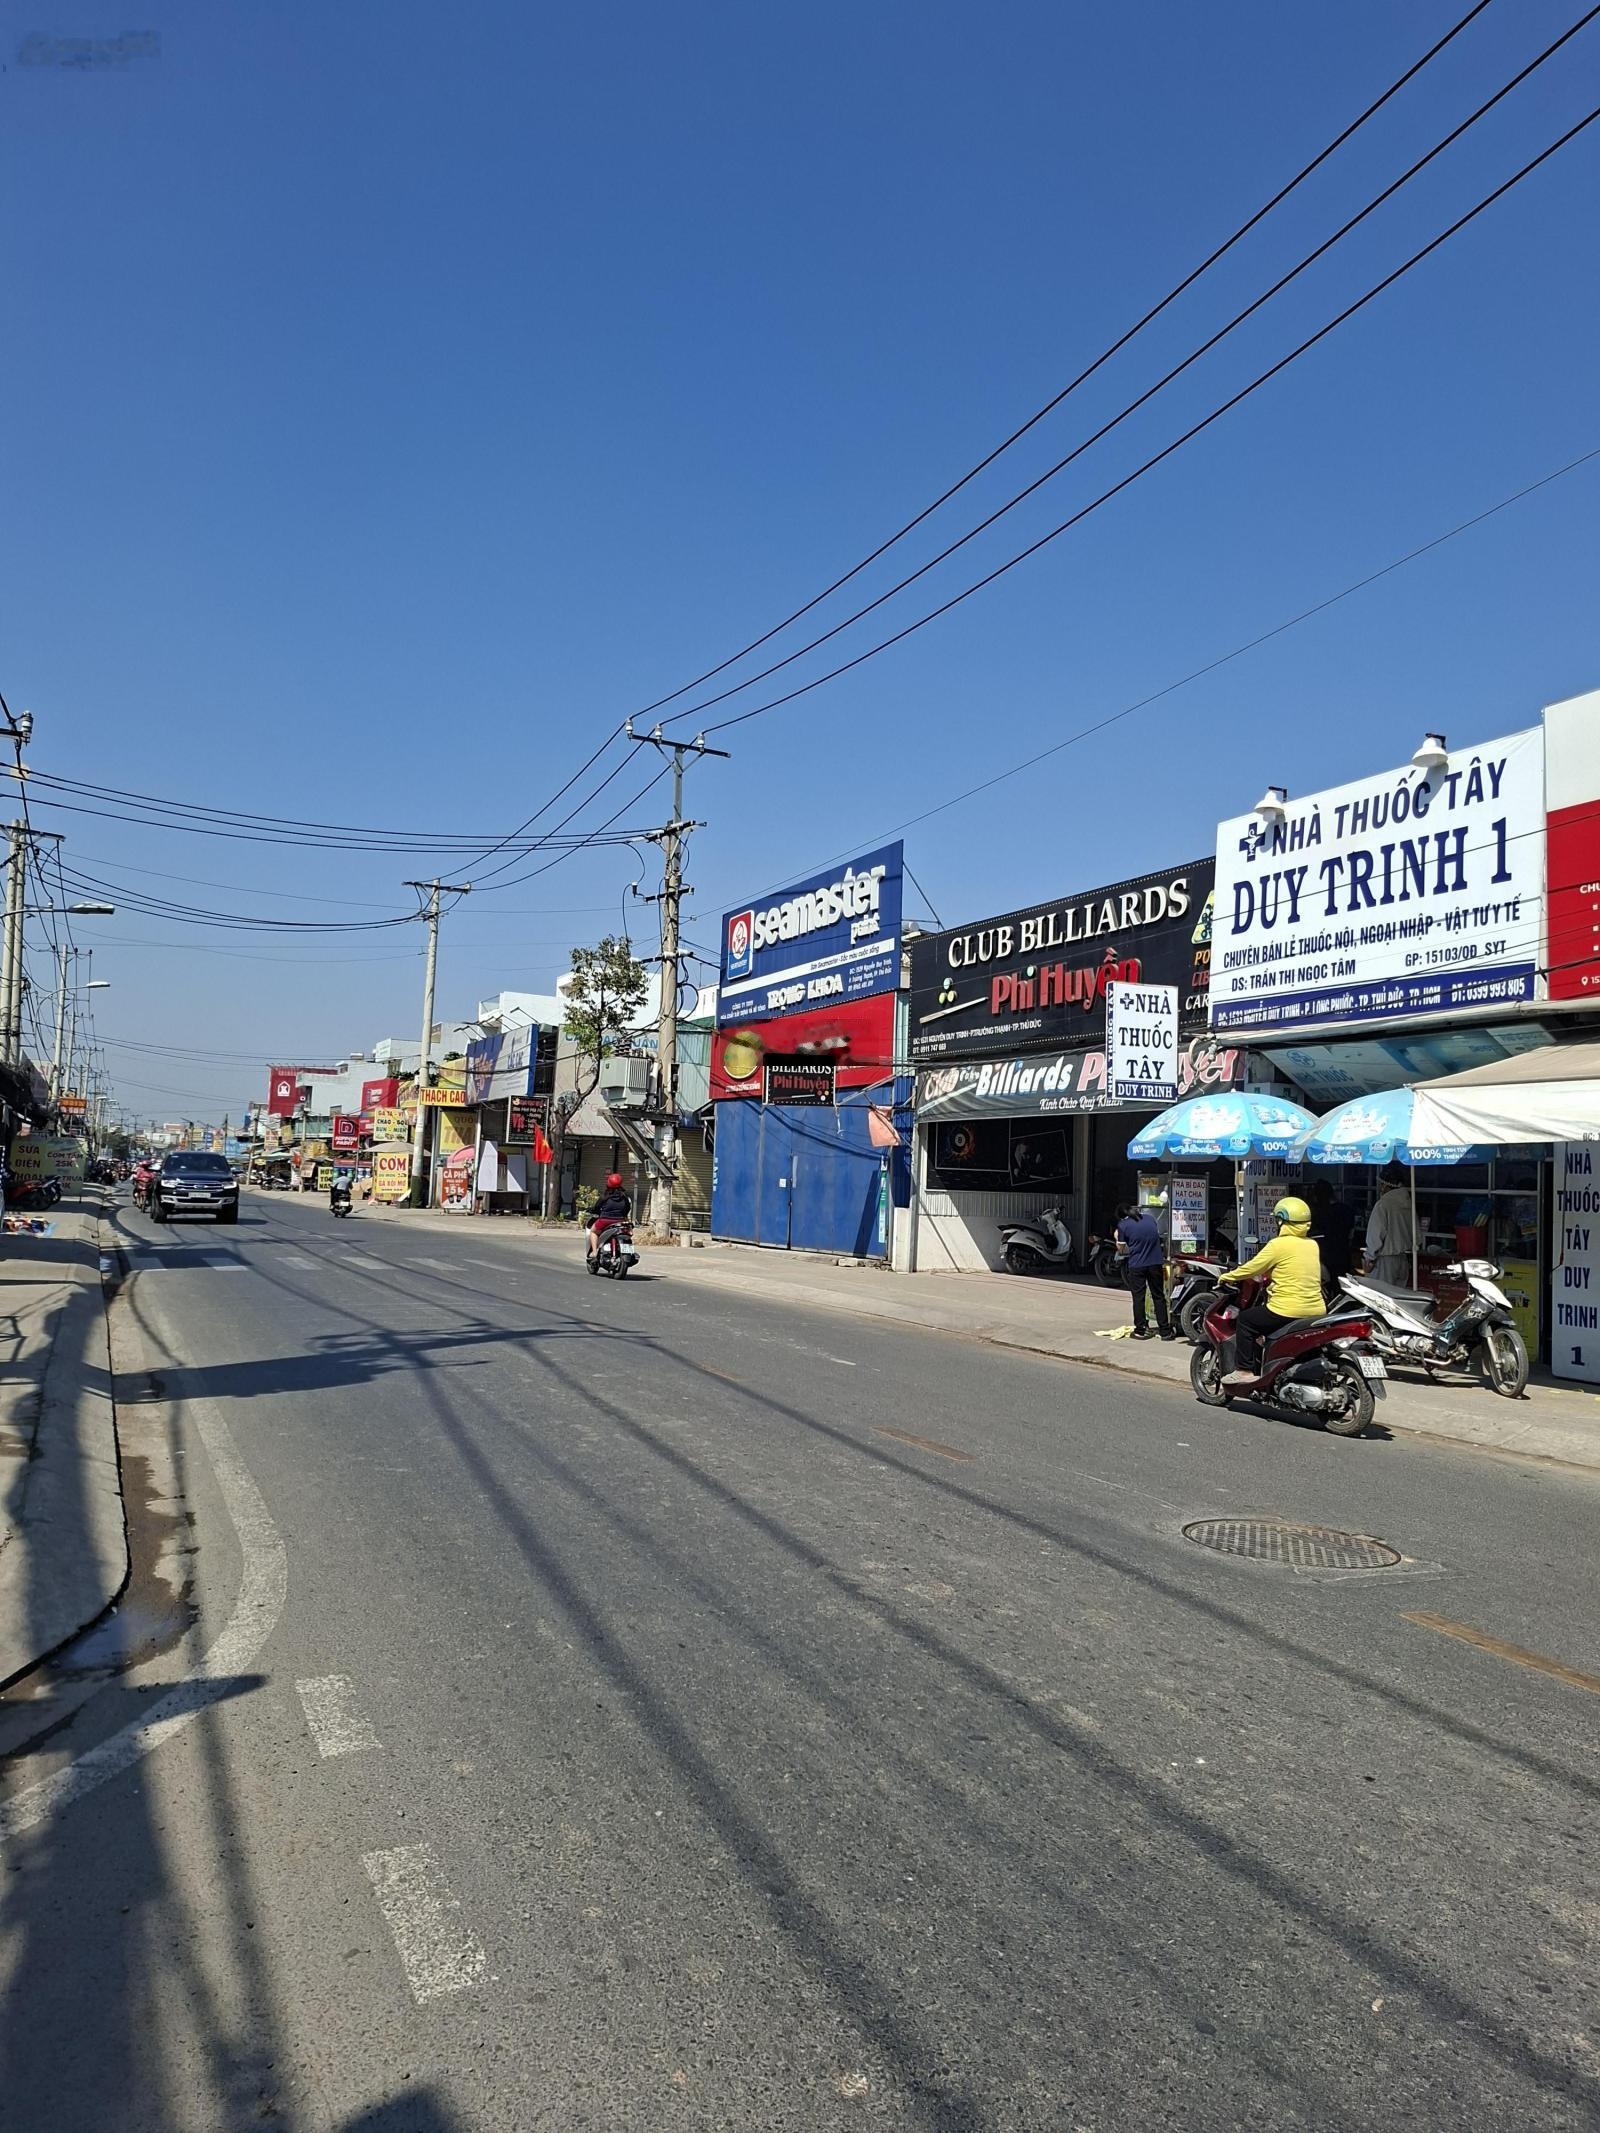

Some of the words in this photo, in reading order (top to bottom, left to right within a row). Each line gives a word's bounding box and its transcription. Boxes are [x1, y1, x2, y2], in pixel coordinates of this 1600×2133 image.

[1272, 804, 1321, 857] NHÀ
[1334, 770, 1431, 839] THUỐC
[1444, 757, 1507, 811] TÂY
[1232, 865, 1308, 936] DUY
[1319, 826, 1468, 917] TRINH
[1491, 817, 1512, 884] 1
[754, 866, 886, 949] seamaster
[948, 925, 1013, 967] CLUB
[1019, 879, 1191, 953] BILLIARDS
[1224, 945, 1260, 968] CHUYÊN
[1262, 940, 1282, 962] BÁN
[1285, 934, 1296, 957] LẺ
[1299, 928, 1332, 956] THUỐC
[1360, 921, 1396, 946] NGOẠI
[1400, 913, 1433, 940] NHẬP
[1445, 907, 1469, 934] VẬT
[1493, 904, 1501, 923] Y
[1504, 893, 1522, 922] TẾ
[1405, 953, 1422, 967] GP:
[808, 974, 843, 999] KHOA
[1232, 977, 1247, 992] DS:
[1279, 969, 1295, 987] THỊ
[1298, 964, 1327, 983] NGỌC
[1331, 958, 1355, 977] TÂM
[1508, 977, 1525, 996] 805
[991, 964, 1036, 1015] Phi
[1136, 990, 1171, 1015] NHÀ
[1119, 1021, 1172, 1049] THUỐC
[976, 1057, 1073, 1096] Billiards
[1127, 1055, 1164, 1080] TÂY
[450, 1088, 466, 1104] CAO
[1117, 1083, 1139, 1097] DUY
[1141, 1084, 1172, 1099] TRINH
[1262, 1141, 1287, 1152] 100%
[1409, 1148, 1441, 1160] 100%
[1565, 1149, 1592, 1175] NHÀ
[1557, 1183, 1600, 1214] THUỐC
[1566, 1224, 1590, 1251] TÂY
[1564, 1266, 1591, 1290] DUY
[1557, 1303, 1598, 1329] TRINH
[1570, 1346, 1585, 1366] 1
